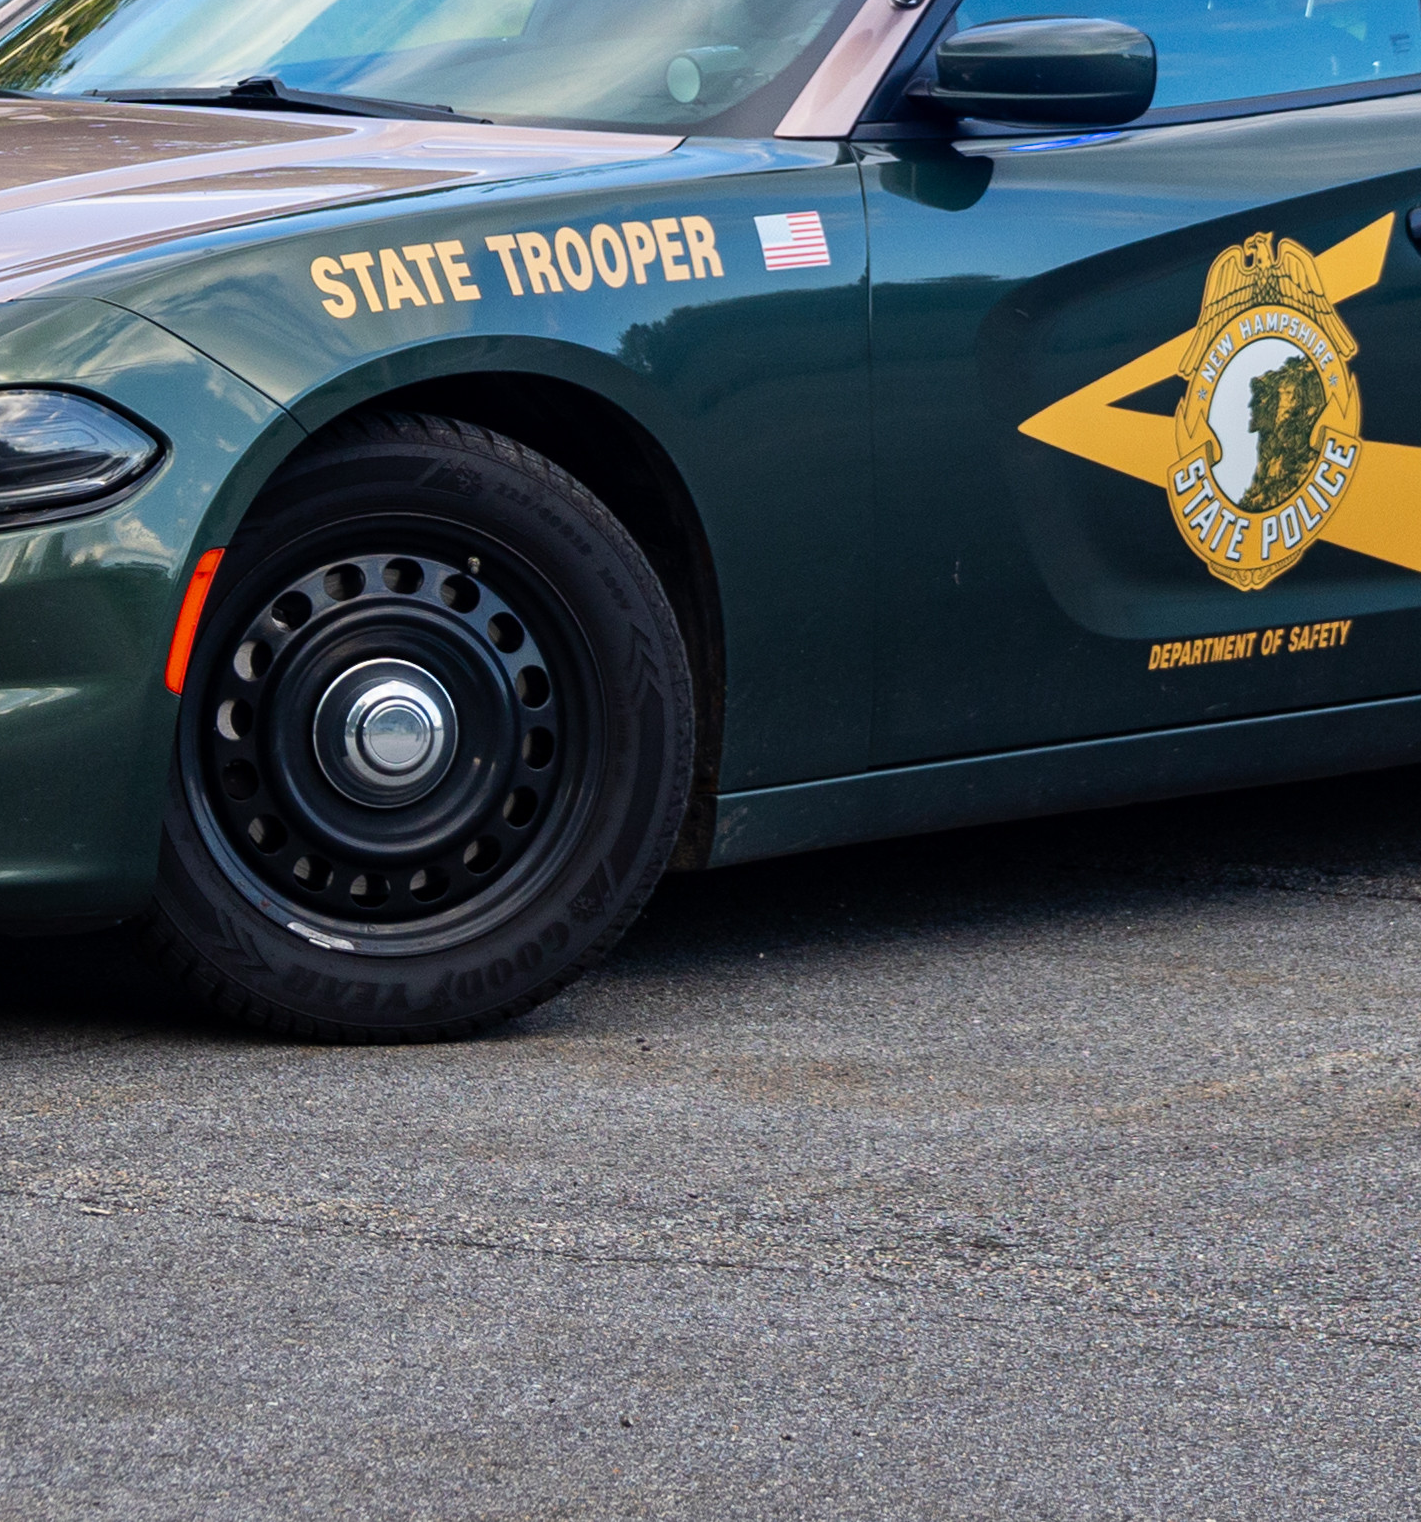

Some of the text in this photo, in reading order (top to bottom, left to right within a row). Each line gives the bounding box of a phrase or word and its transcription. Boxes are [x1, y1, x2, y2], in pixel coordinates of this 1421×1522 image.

[310, 215, 724, 319] STATE TROOPER
[1201, 312, 1334, 383] NEW HAMPSHIRE
[1174, 438, 1357, 562] STATE POLICE
[1148, 619, 1353, 671] DEPARTMENT OF SAFETY
